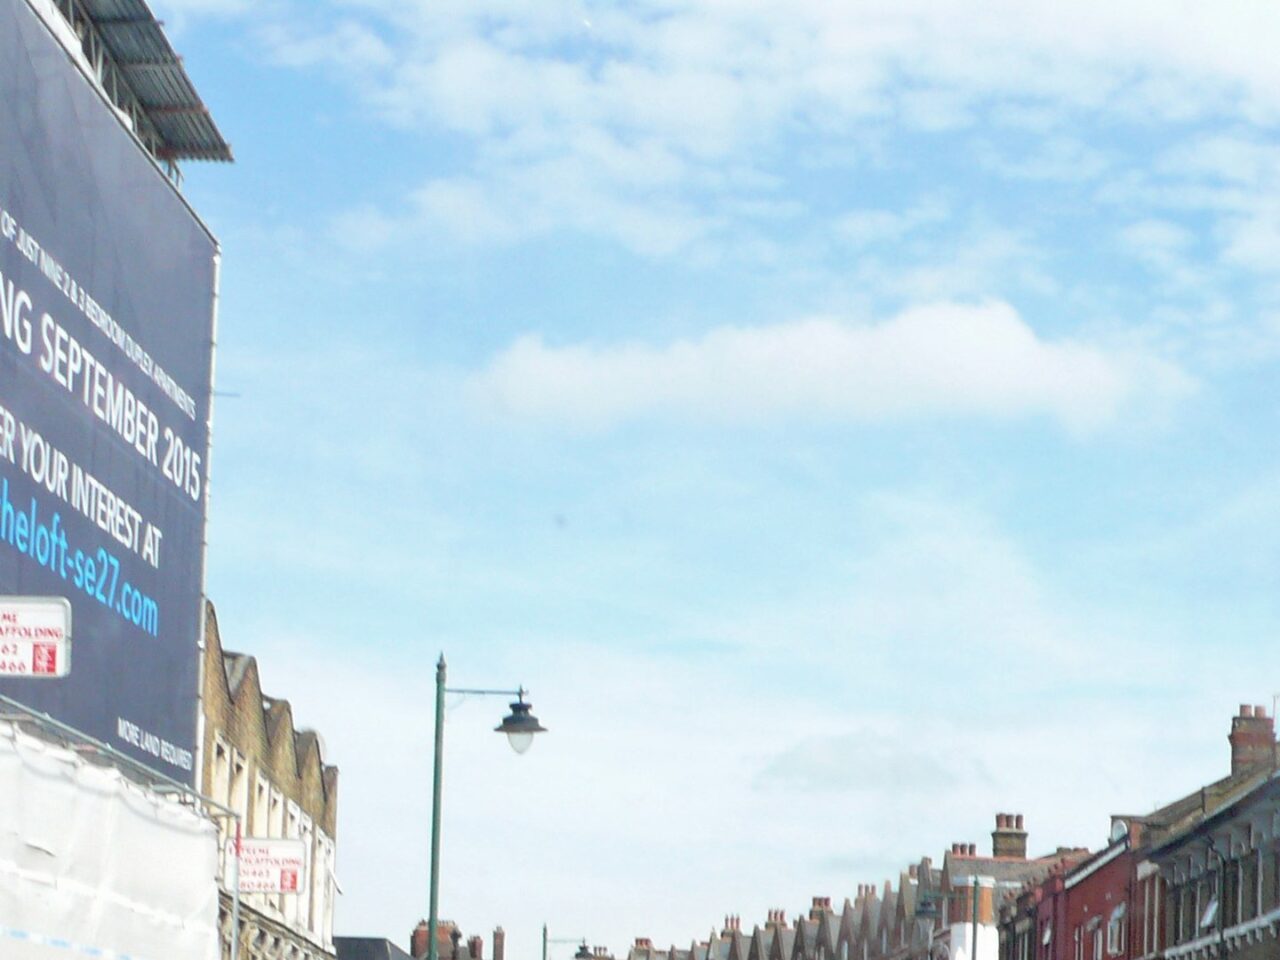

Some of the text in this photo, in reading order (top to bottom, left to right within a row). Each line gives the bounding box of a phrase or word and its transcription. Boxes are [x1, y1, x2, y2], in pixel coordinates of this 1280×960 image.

[0, 269, 201, 502] NG SEPTEMBER 2015
[0, 477, 160, 638] heloft-se27.com
[19, 421, 69, 503] YOUR
[71, 462, 143, 554] INTEREST
[141, 521, 163, 570] AT
[118, 715, 140, 751] MORE
